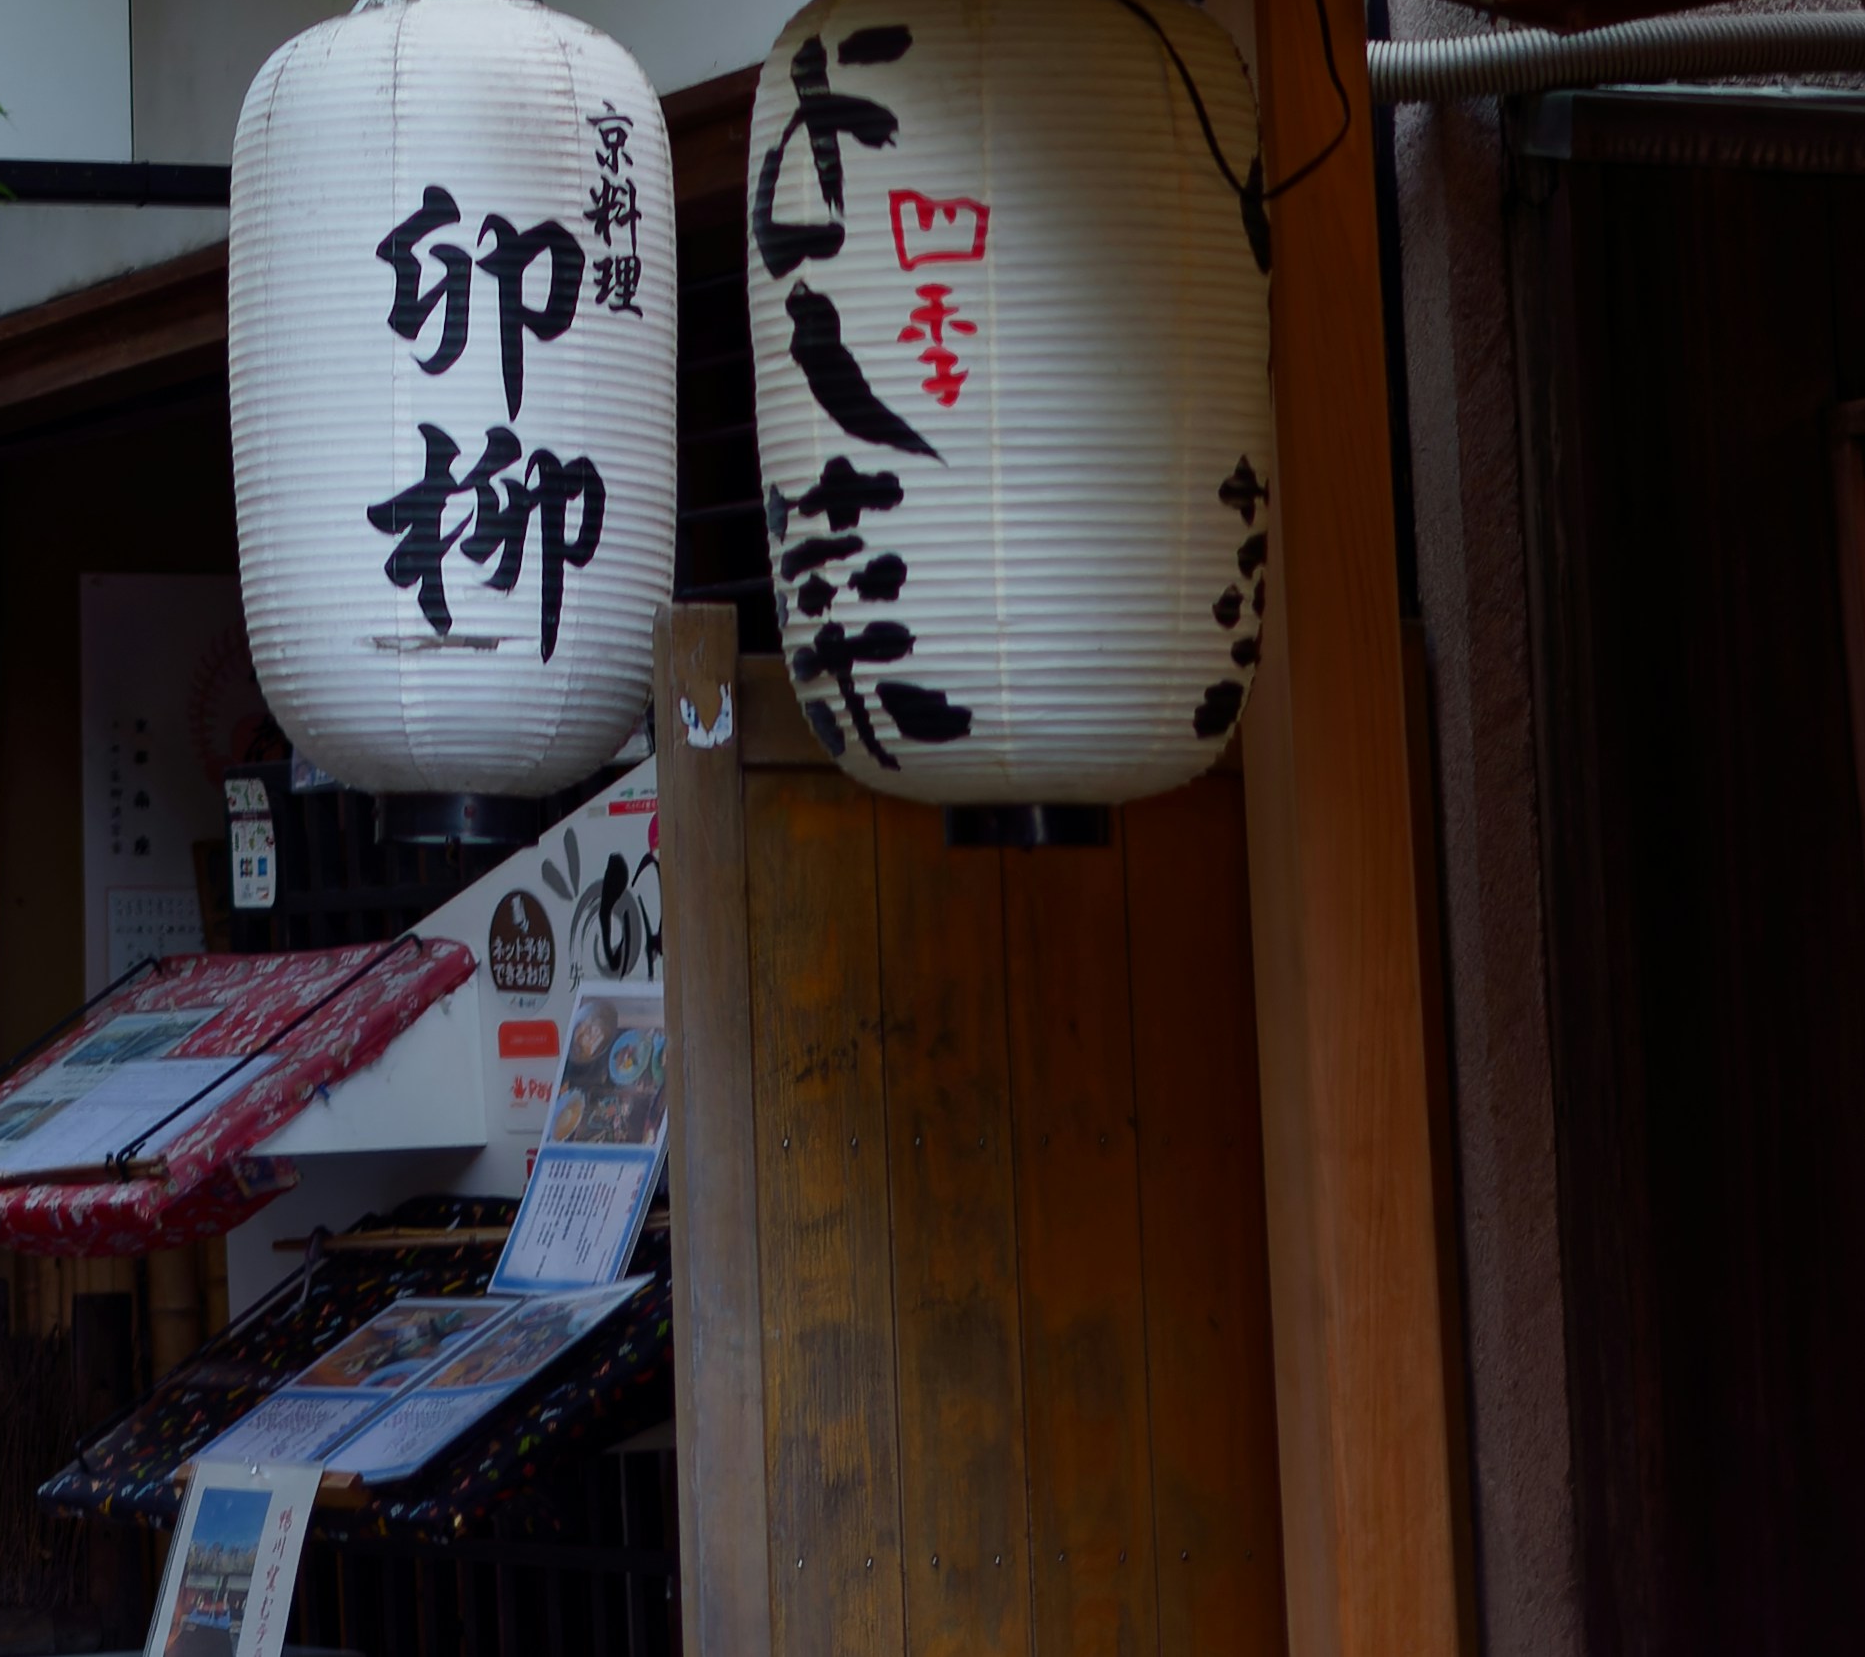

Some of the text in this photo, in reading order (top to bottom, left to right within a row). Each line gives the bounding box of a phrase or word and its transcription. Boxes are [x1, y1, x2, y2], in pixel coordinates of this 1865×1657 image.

[580, 101, 646, 321] 京料理
[887, 189, 990, 407] 四季
[364, 184, 610, 666] 卯柳
